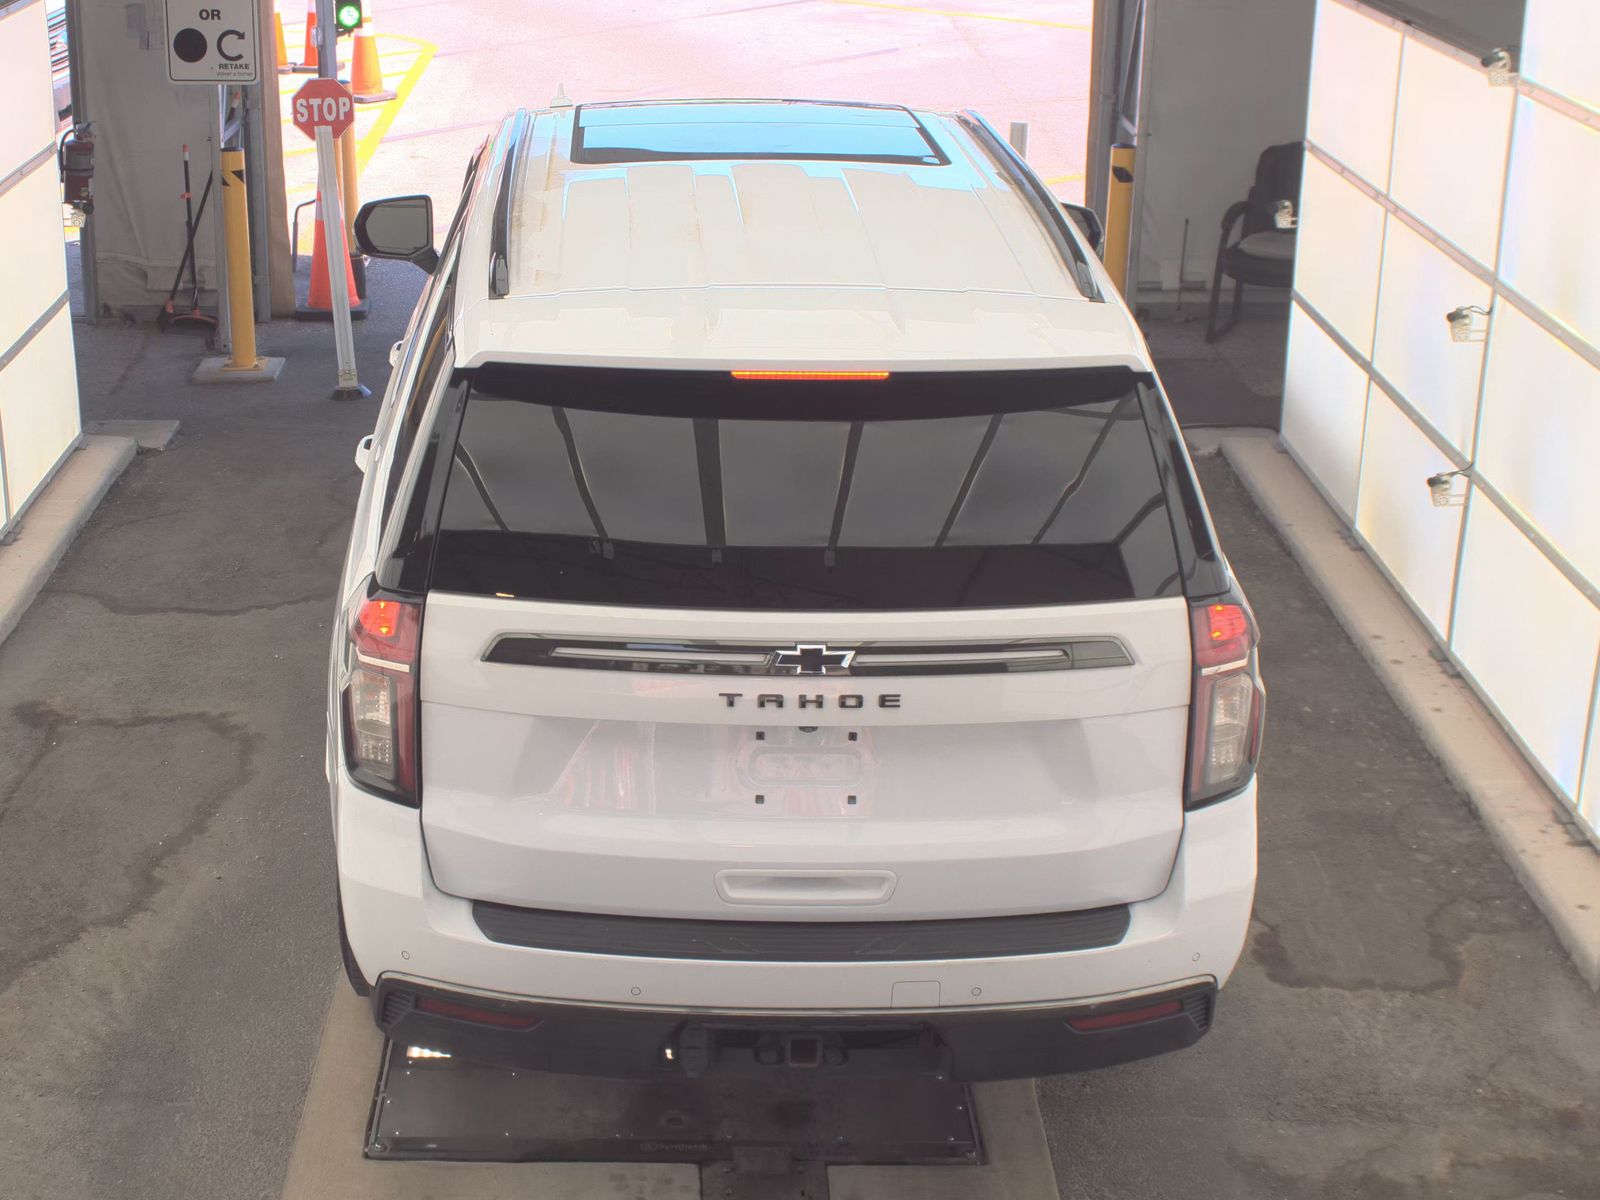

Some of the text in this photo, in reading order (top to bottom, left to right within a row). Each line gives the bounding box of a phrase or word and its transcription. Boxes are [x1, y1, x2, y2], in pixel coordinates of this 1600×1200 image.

[199, 8, 221, 20] OR
[295, 96, 351, 123] STOP
[719, 693, 901, 709] TAHOE
